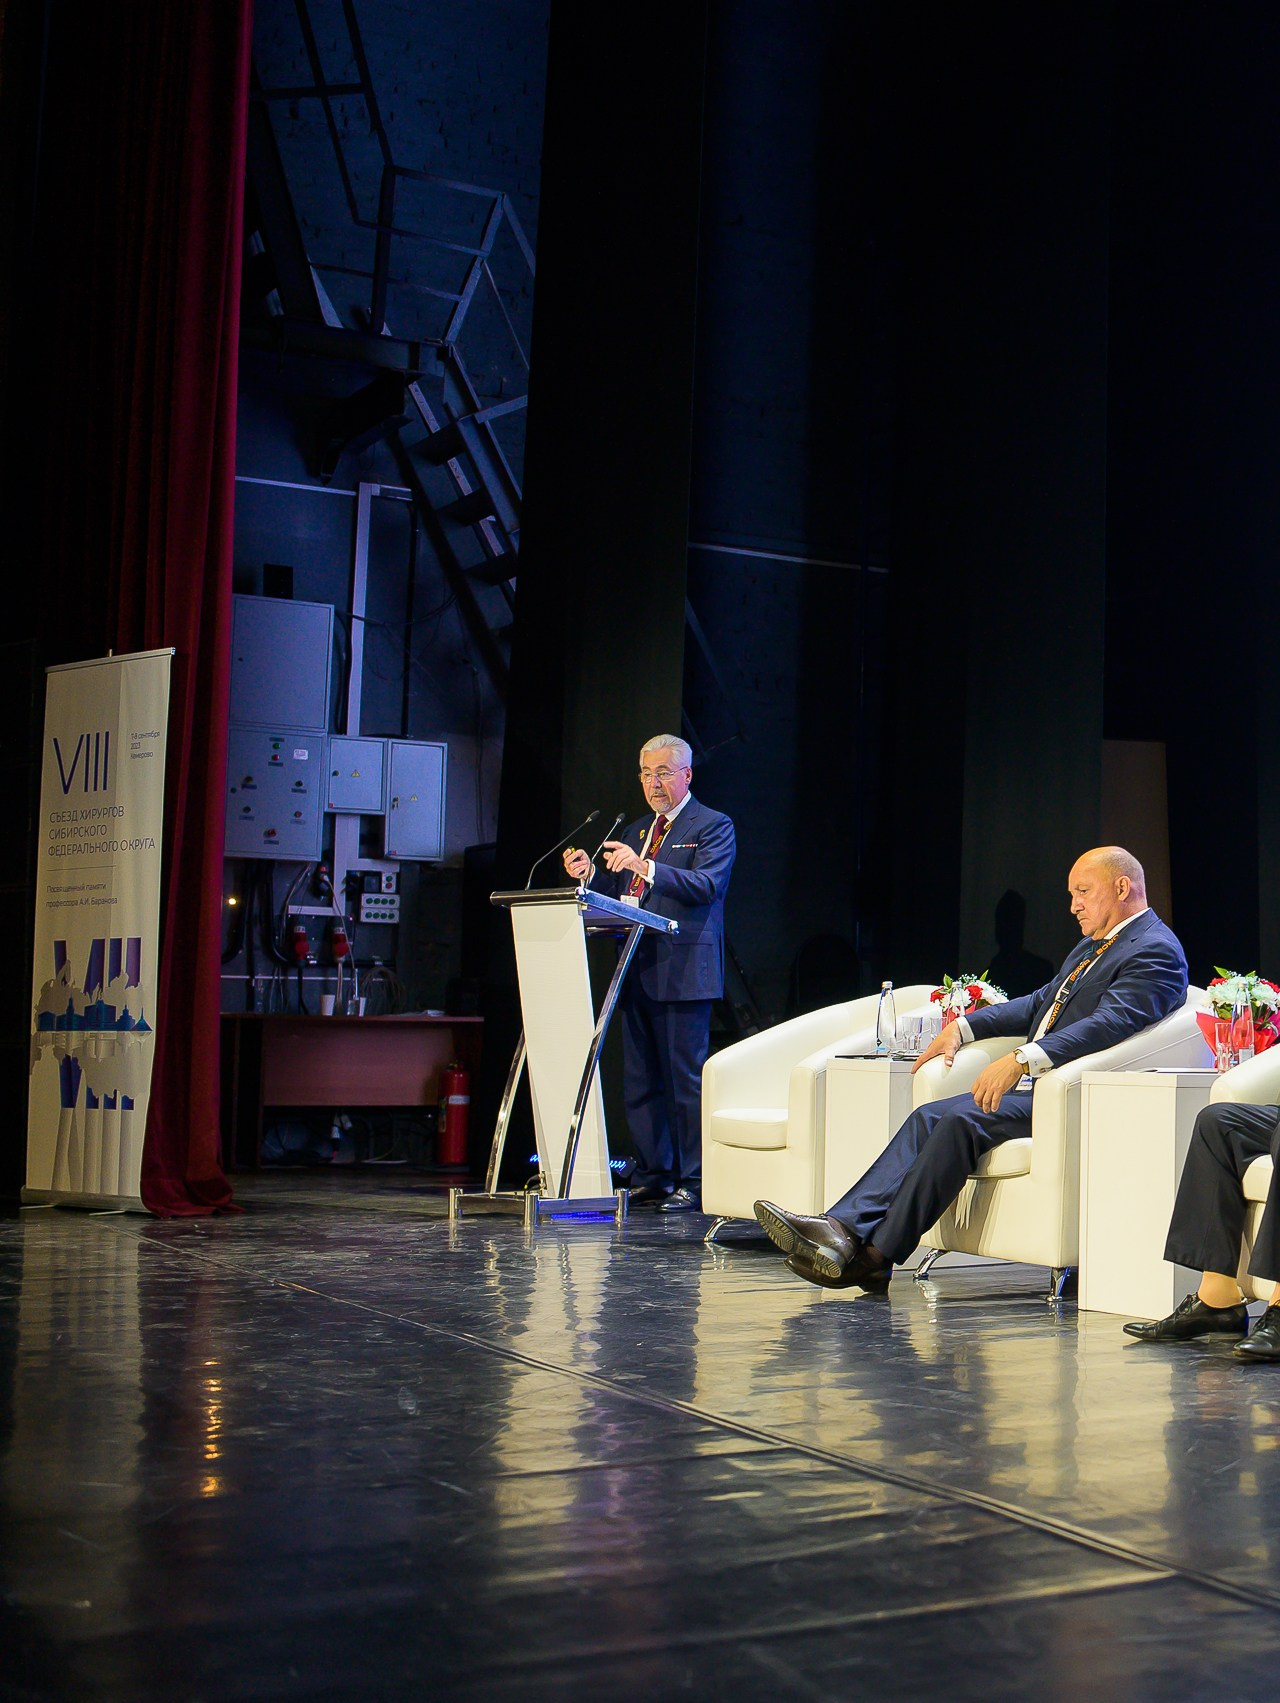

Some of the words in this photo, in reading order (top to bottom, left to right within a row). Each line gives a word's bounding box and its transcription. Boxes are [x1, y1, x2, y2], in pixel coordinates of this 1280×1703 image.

[53, 731, 110, 795] VIII
[49, 810, 78, 824] СЪЕЗД
[79, 805, 125, 821] ХИРУРГОВ
[48, 824, 108, 840] СИБИРСКОГО
[48, 840, 119, 857] ФЕДЕРАЛЬНОГО
[120, 838, 156, 852] ОКРУГА
